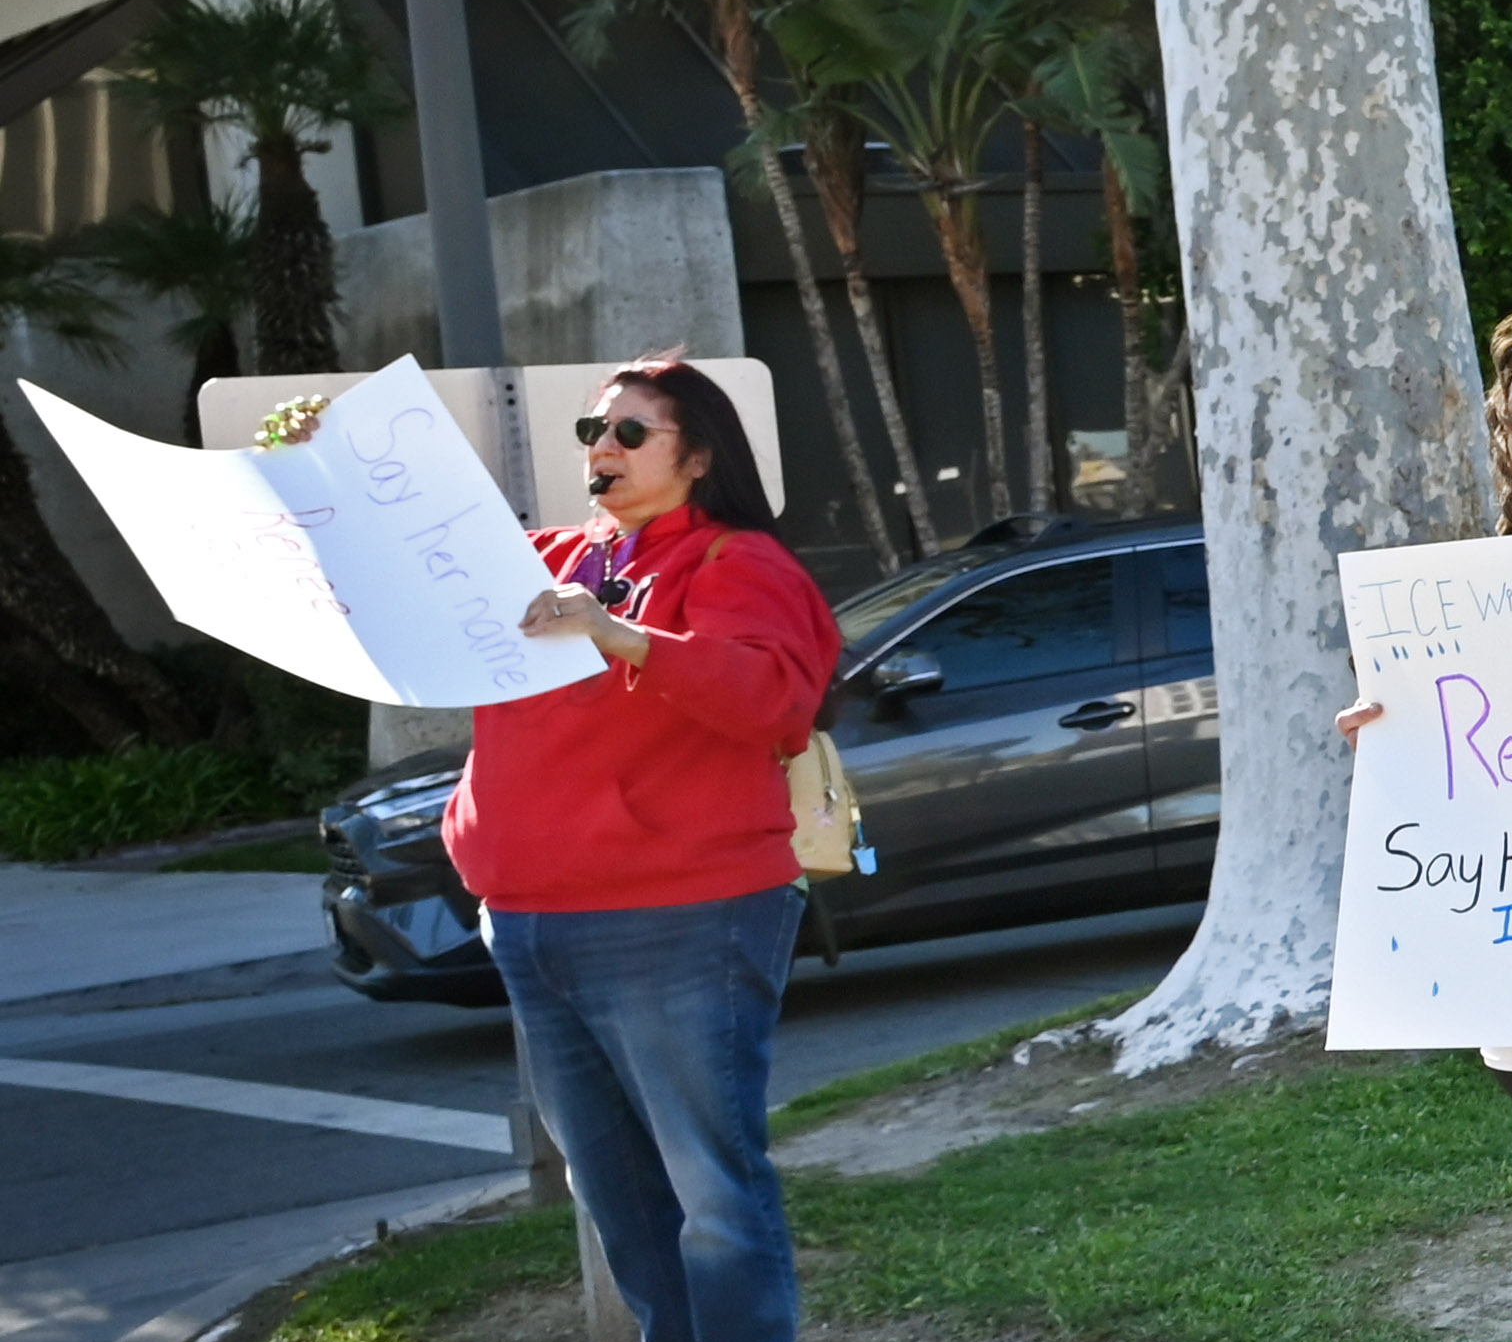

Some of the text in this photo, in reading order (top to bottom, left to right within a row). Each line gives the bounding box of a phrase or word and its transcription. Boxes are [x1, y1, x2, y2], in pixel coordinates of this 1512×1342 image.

[347, 405, 530, 692] Say her name
[1359, 579, 1462, 640] ICE
[1376, 822, 1485, 914] Say
